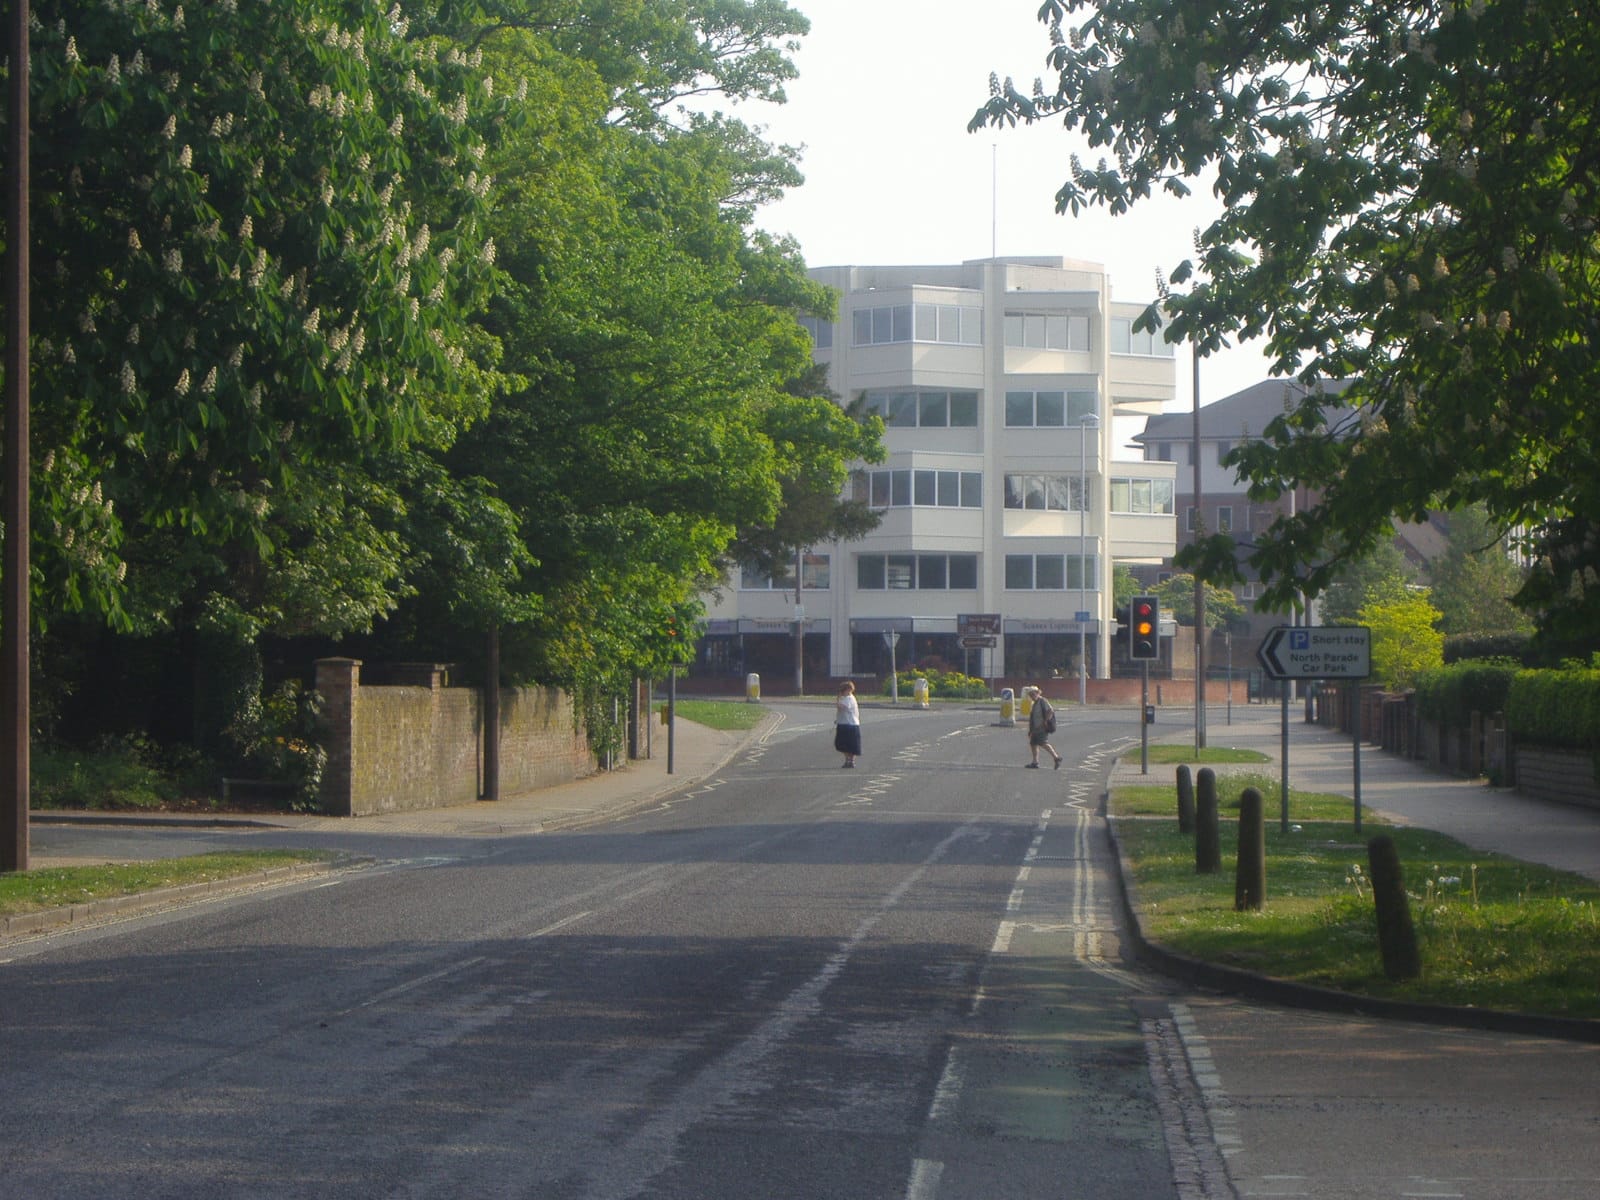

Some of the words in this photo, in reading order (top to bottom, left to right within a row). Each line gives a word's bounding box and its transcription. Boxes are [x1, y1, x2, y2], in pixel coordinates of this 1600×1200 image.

[1295, 632, 1306, 647] P
[1312, 635, 1340, 644] Short
[1345, 635, 1365, 646] stay
[1291, 653, 1321, 662] North
[1324, 653, 1360, 662] Parade
[1302, 664, 1321, 672] Car
[1324, 664, 1347, 672] Park
